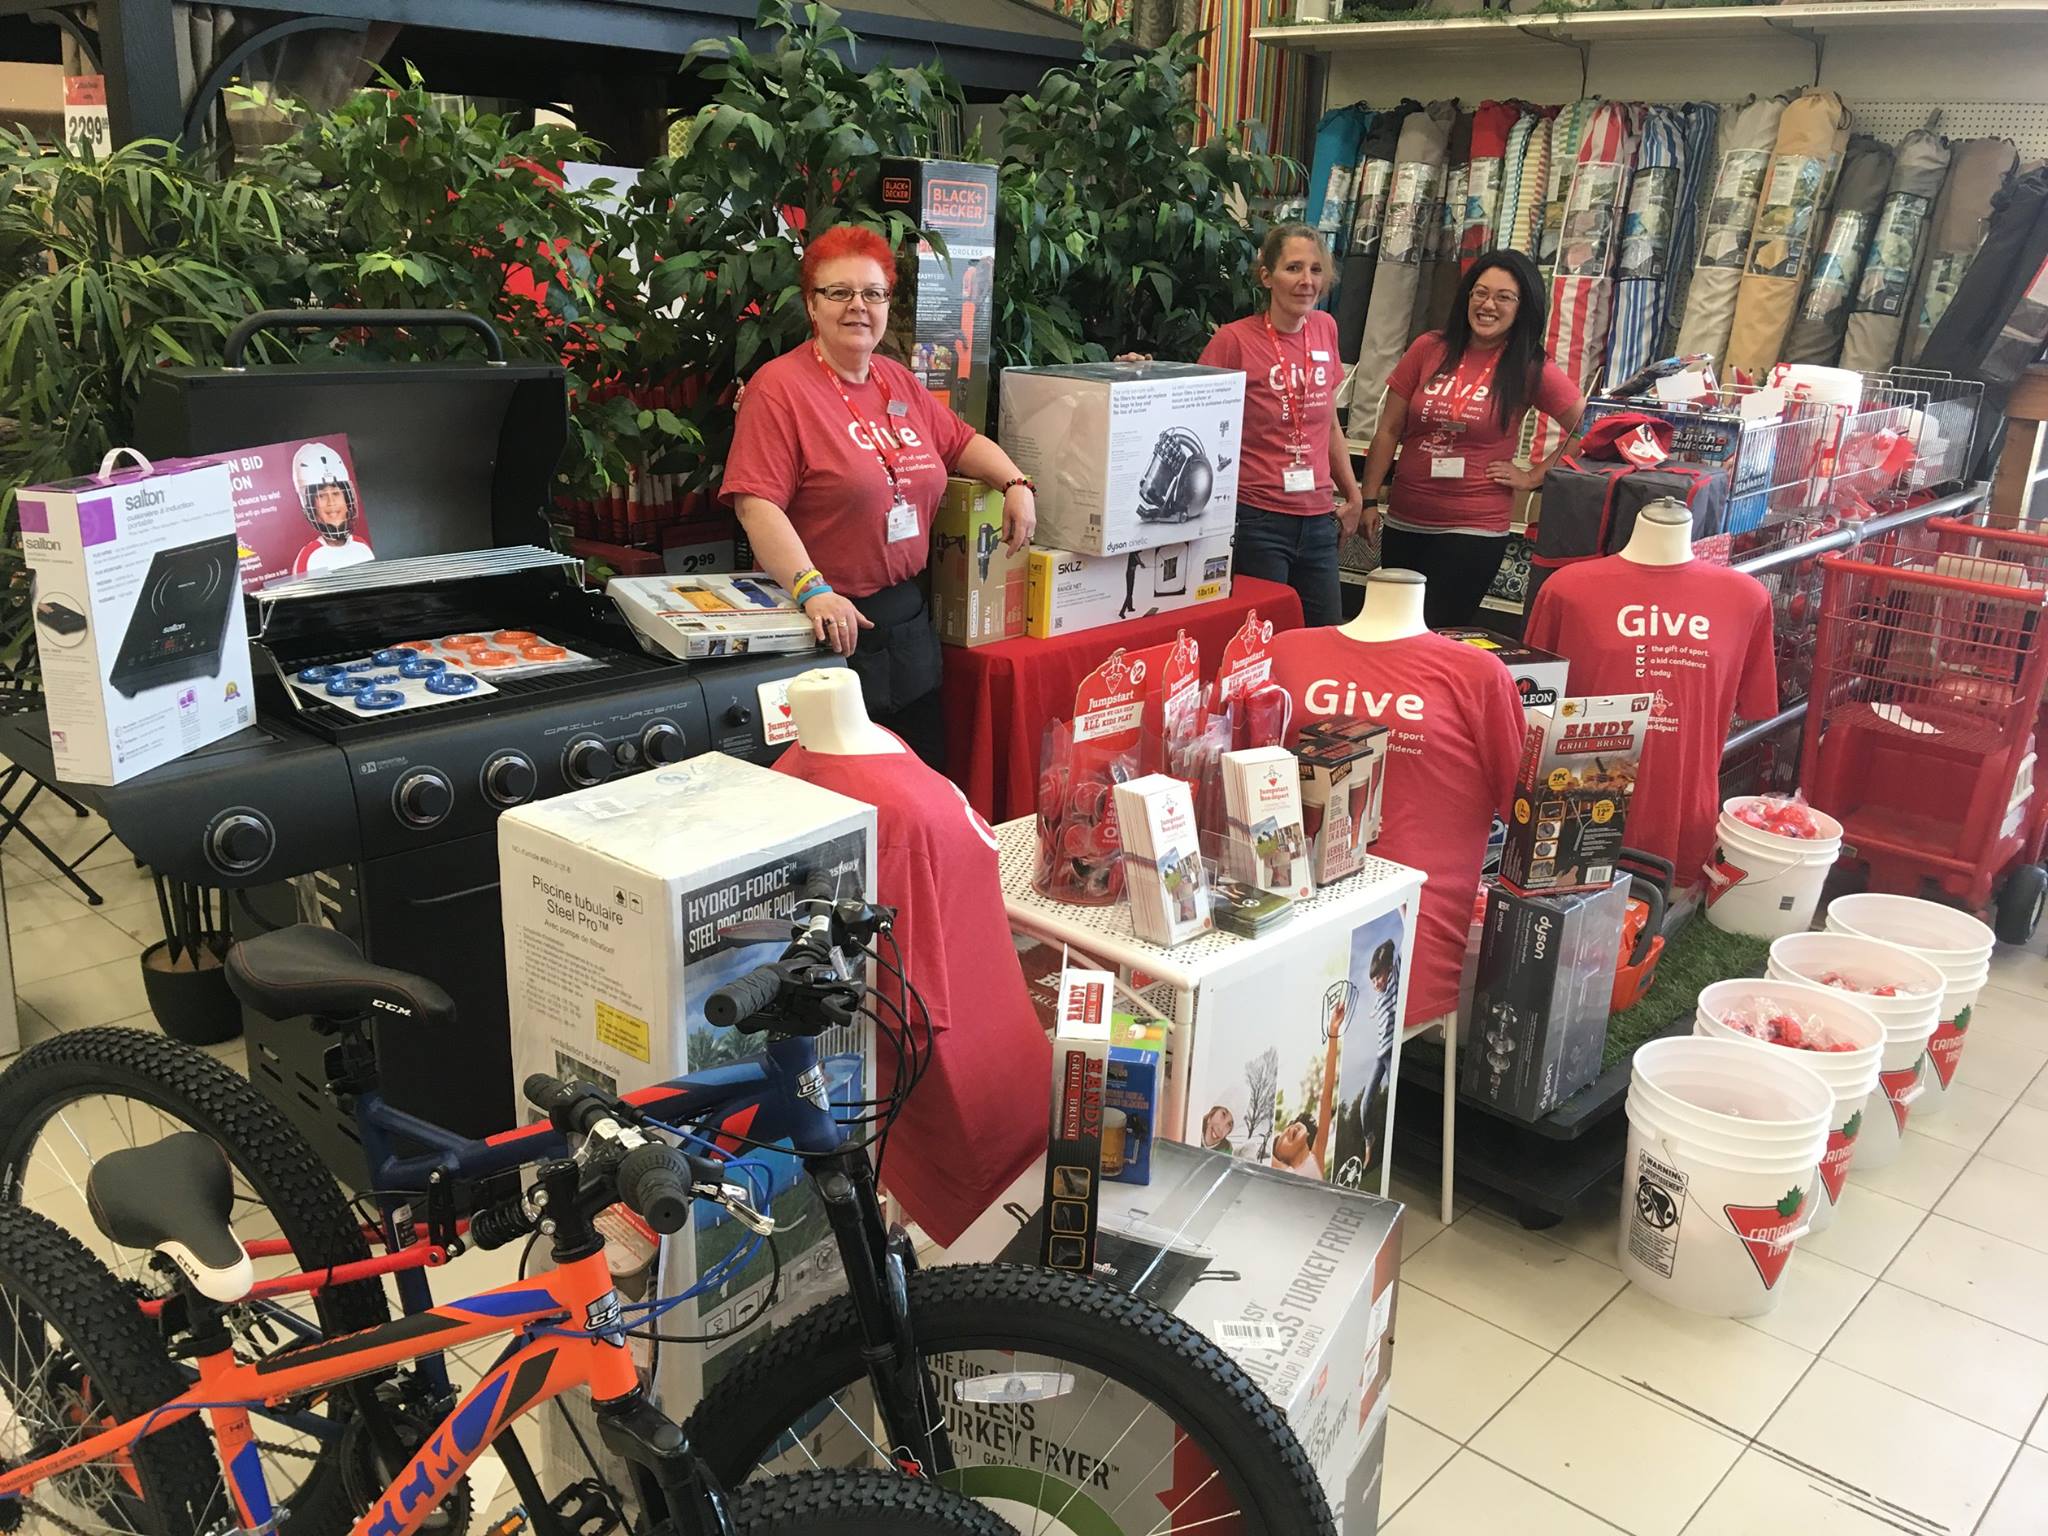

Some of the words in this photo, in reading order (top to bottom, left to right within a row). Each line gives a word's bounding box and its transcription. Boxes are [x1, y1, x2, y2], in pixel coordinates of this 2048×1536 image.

[933, 187, 983, 204] BLACK+
[932, 203, 984, 220] DECKER
[952, 246, 984, 257] ORDLESS
[848, 420, 922, 451] Give
[240, 455, 264, 472] BID
[125, 489, 166, 512] salton
[26, 537, 62, 551] salton
[1106, 541, 1128, 553] dyson
[1057, 560, 1082, 575] SKLZ
[1616, 604, 1711, 641] Give
[1651, 645, 1663, 653] the
[1664, 645, 1678, 655] gift
[1679, 646, 1689, 654] of
[1656, 656, 1668, 665] kid
[1087, 689, 1135, 713] Jumpstart
[1304, 677, 1425, 722] Give
[1632, 701, 1648, 712] TV
[1564, 719, 1634, 739] HANDY
[1558, 741, 1589, 751] GRILL
[1596, 737, 1631, 750] BRUSH
[532, 874, 572, 904] Piscine
[574, 892, 624, 926] tubulaire
[546, 898, 575, 923] Steel
[688, 921, 717, 954] STEEL
[1534, 914, 1553, 961] dyson
[1066, 983, 1086, 1022] HANDY
[1071, 1054, 1082, 1091] GRILL
[1083, 1057, 1104, 1139] HANDY
[1067, 1097, 1079, 1138] BRUSH
[1646, 1155, 1685, 1182] WARNING
[176, 1254, 200, 1280] CCM
[1279, 1249, 1340, 1313] TURKEY
[1316, 1204, 1367, 1254] FRYER
[941, 1403, 1022, 1458] URKEY
